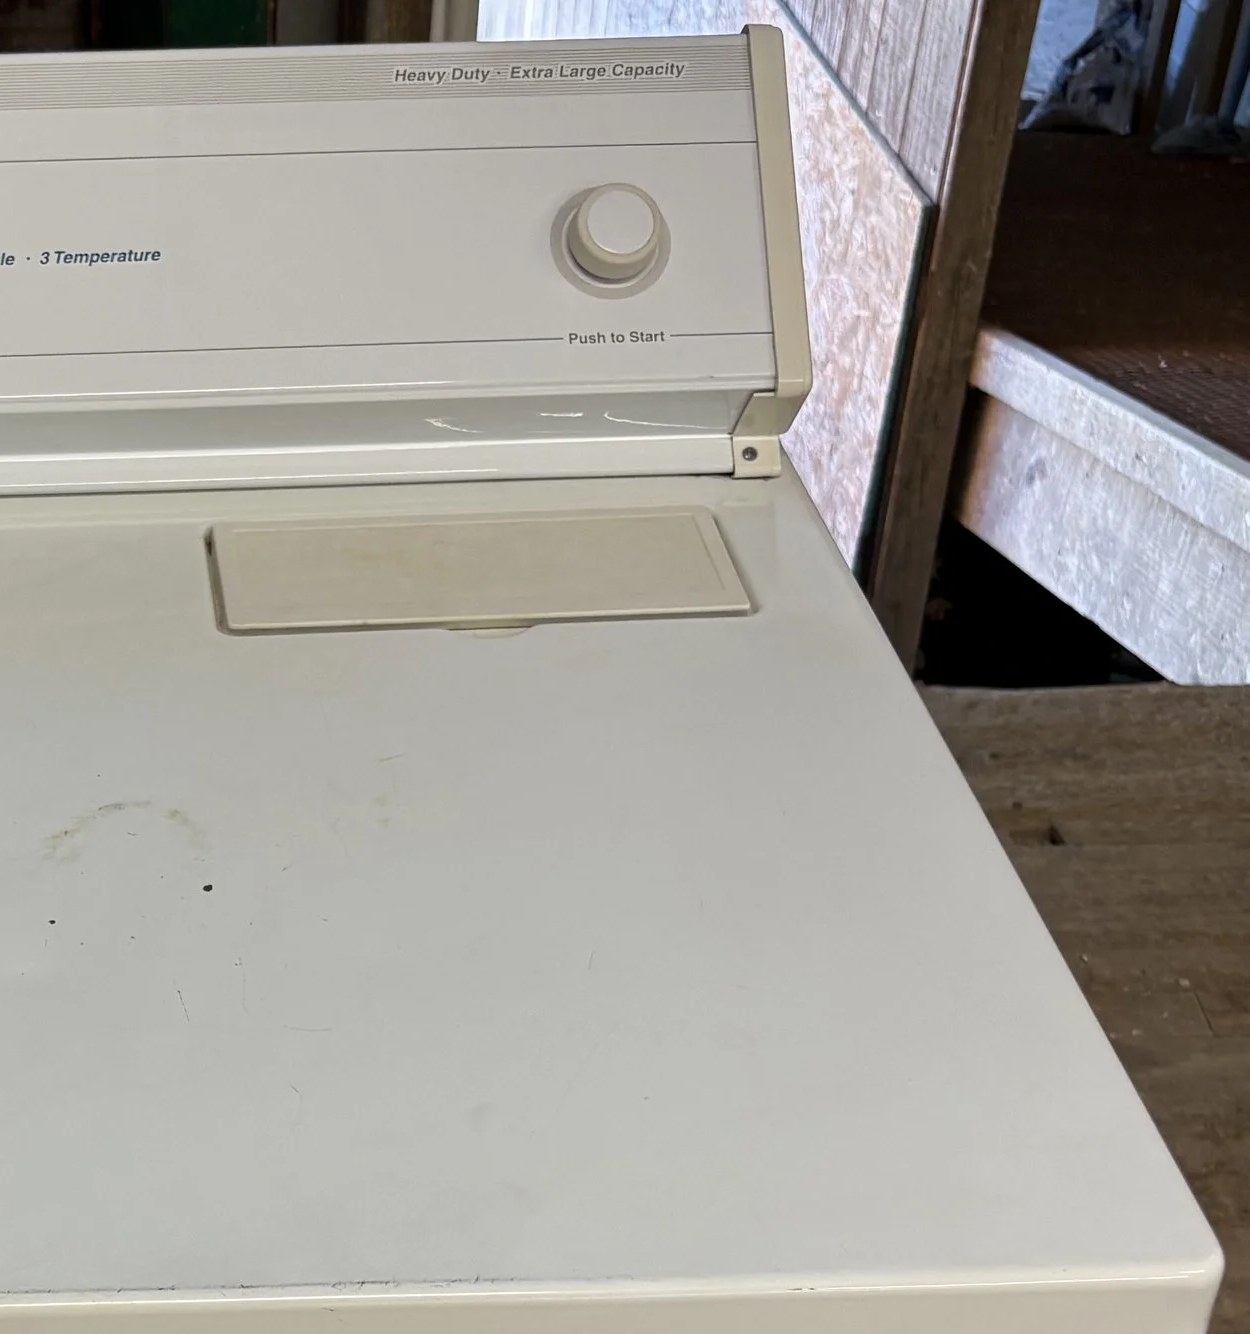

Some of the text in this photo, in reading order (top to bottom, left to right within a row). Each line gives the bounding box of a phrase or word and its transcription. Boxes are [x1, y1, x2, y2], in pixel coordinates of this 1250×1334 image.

[395, 62, 685, 85] Heavy Duty Extra Large Capacity
[39, 251, 50, 265] 3
[54, 249, 161, 266] Temperature
[569, 330, 665, 344] Push to Start
